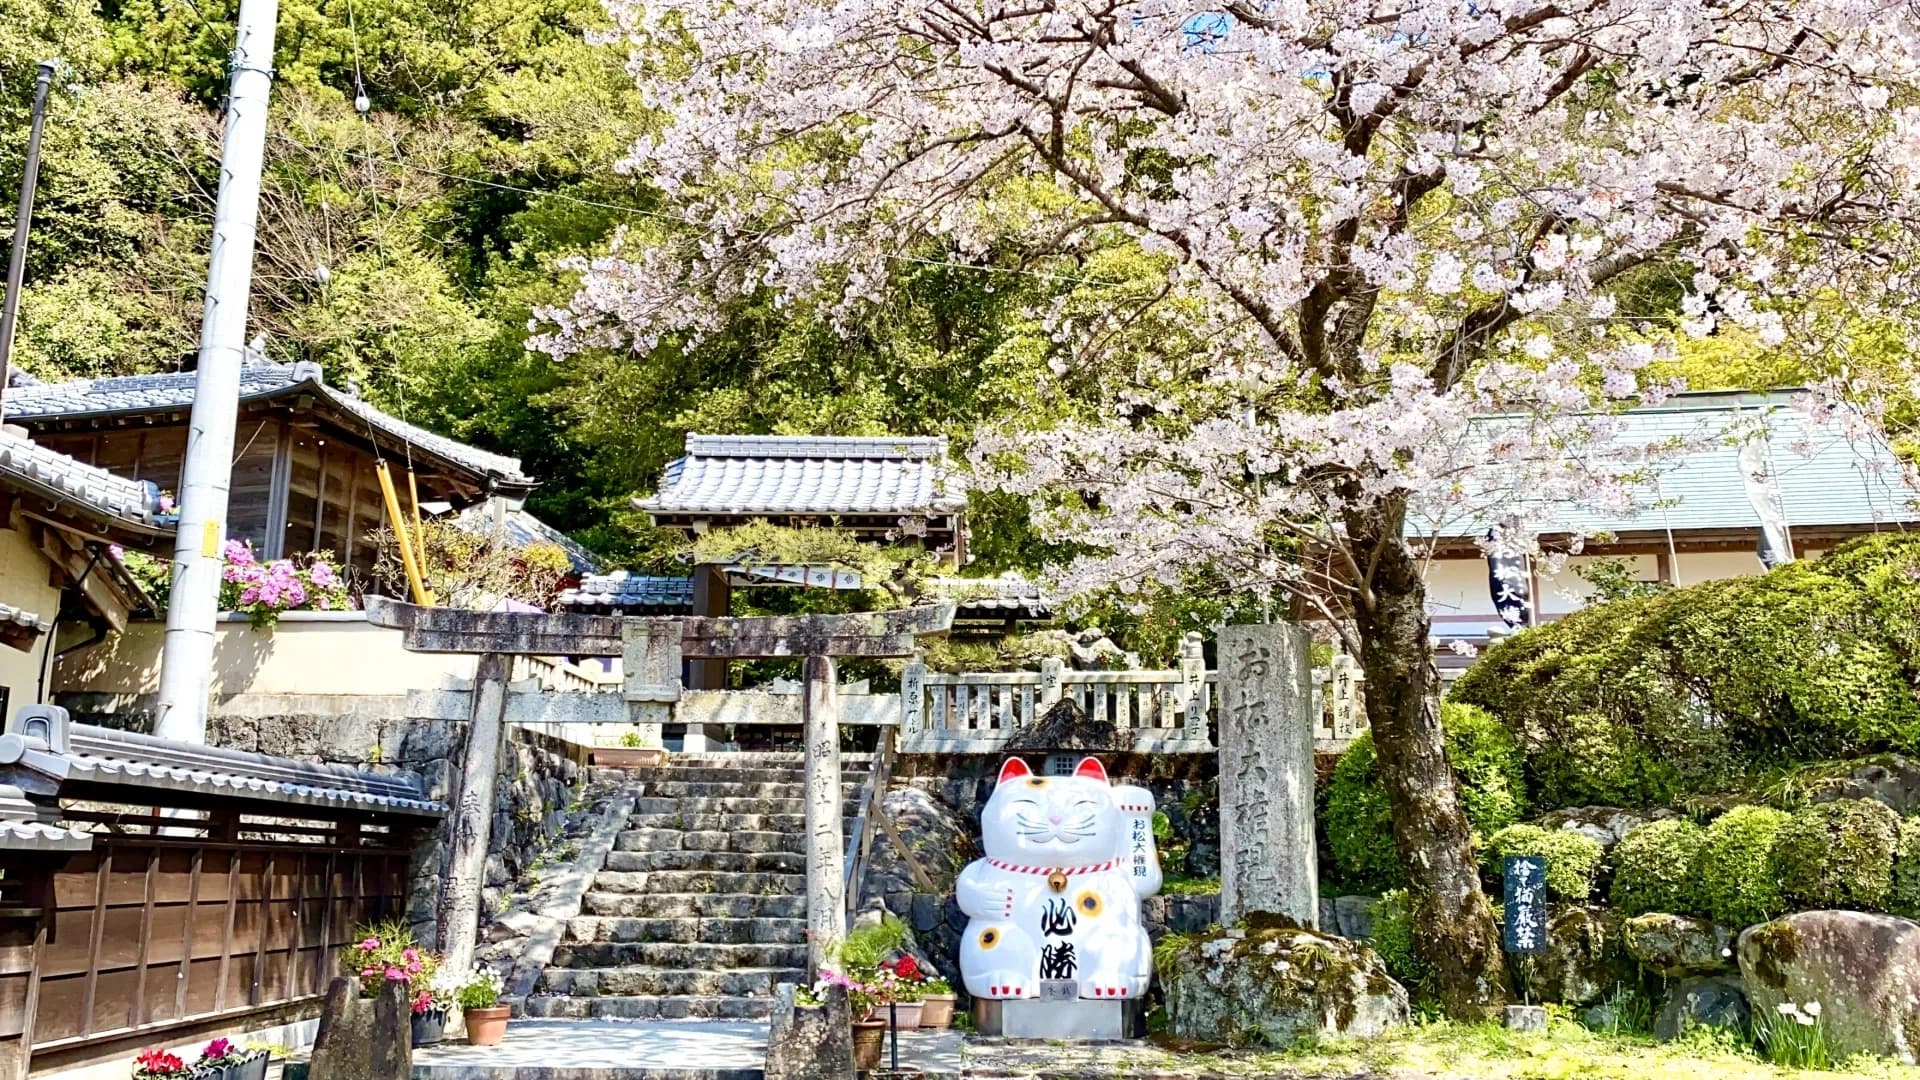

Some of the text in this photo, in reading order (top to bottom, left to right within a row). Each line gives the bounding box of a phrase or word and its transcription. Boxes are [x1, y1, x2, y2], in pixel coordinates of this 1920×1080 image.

[1132, 819, 1147, 877] お松大権現
[1040, 897, 1078, 980] 必勝
